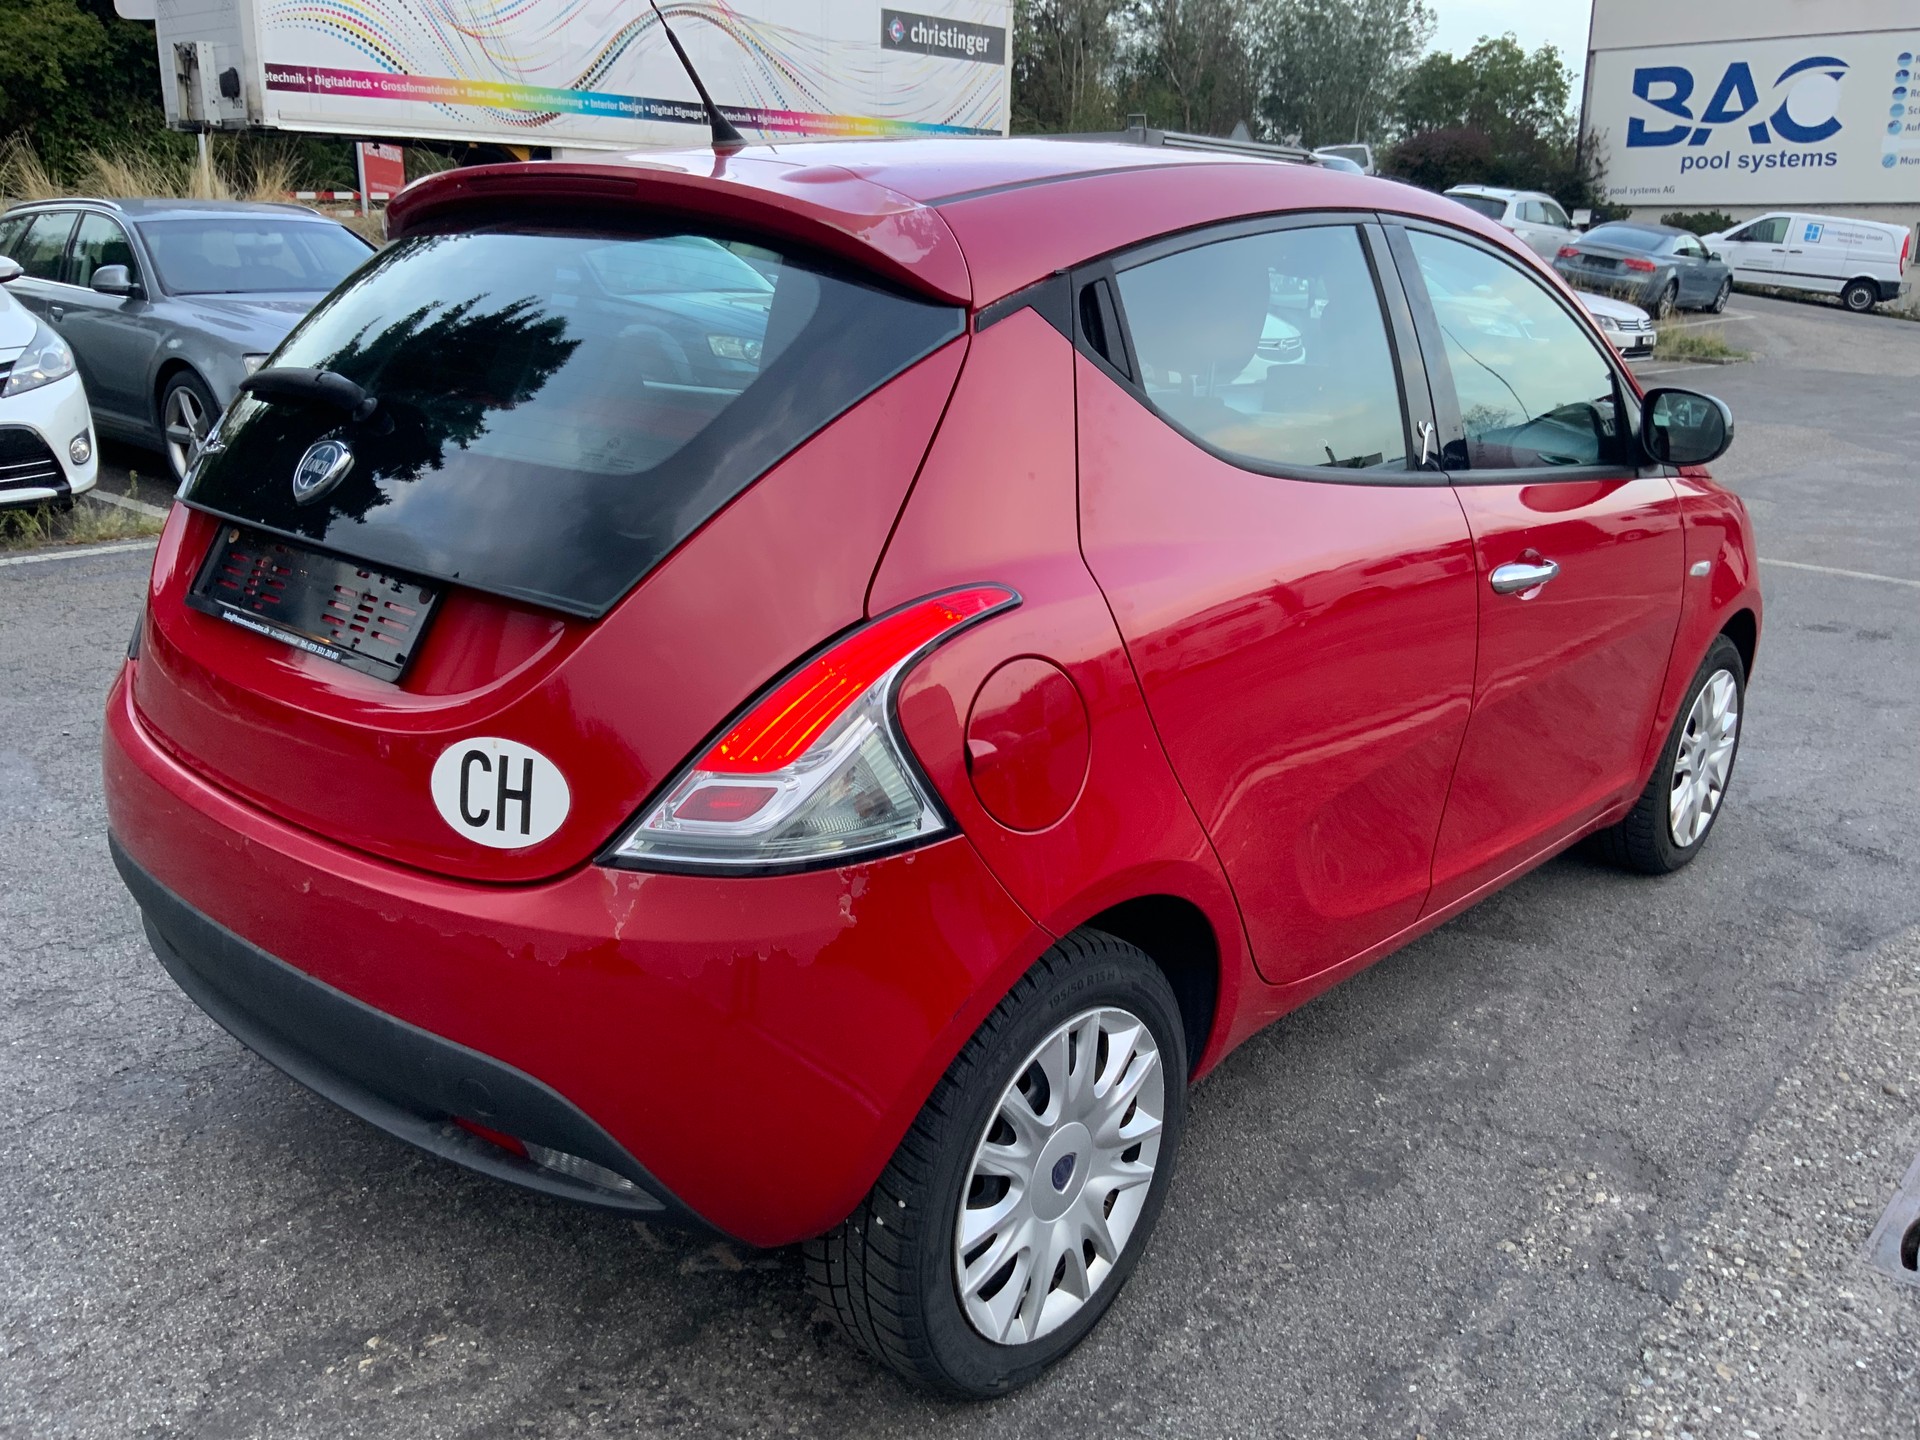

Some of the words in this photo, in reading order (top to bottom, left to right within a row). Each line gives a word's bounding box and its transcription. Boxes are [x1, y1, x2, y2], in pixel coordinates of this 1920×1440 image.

[910, 21, 990, 55] christinger
[314, 75, 373, 90] Digitaldruck
[380, 80, 460, 97] Grossformatdruck
[590, 98, 618, 111] Interior
[619, 101, 644, 115] Design
[650, 104, 674, 116] Digital
[674, 106, 702, 119] Signage
[757, 114, 795, 126] Digitaldruck
[1626, 56, 1850, 148] BAC
[1680, 151, 1731, 174] pool
[1737, 150, 1839, 174] systems
[1609, 186, 1628, 196] pool
[1629, 186, 1661, 196] systems
[1662, 184, 1675, 194] AG
[459, 749, 534, 836] CH
